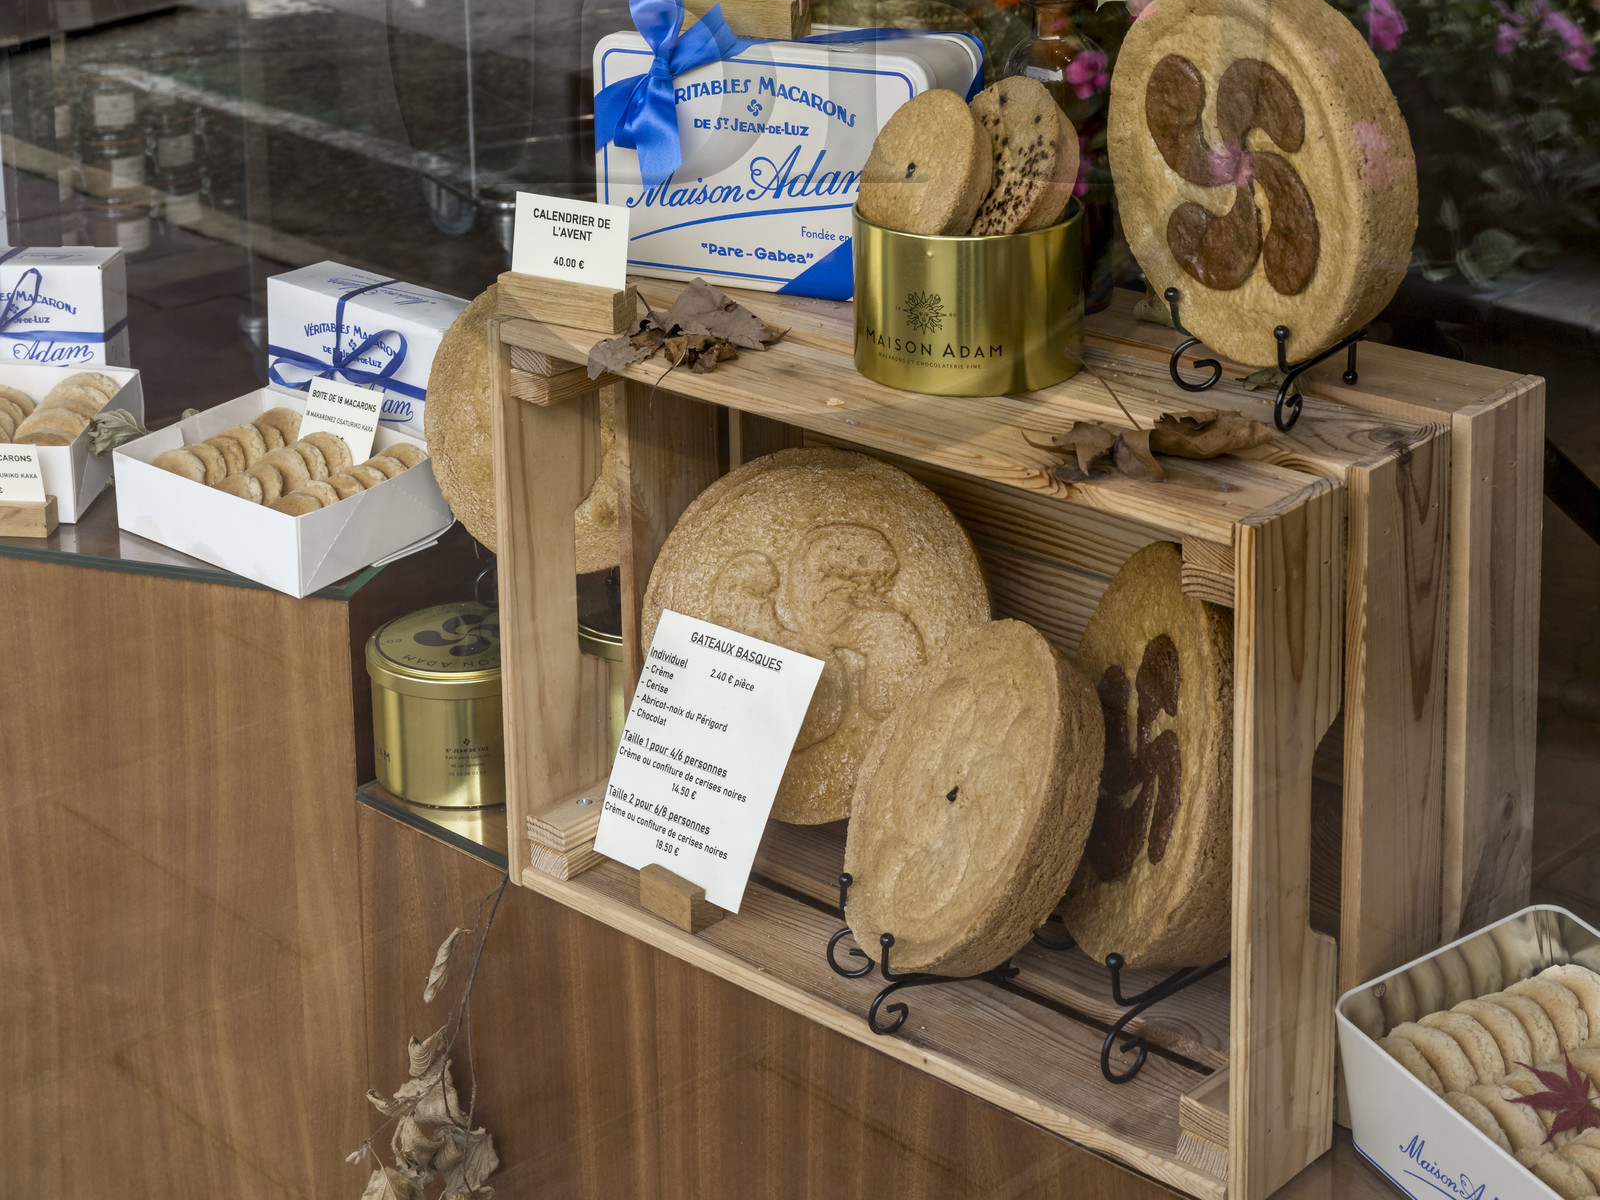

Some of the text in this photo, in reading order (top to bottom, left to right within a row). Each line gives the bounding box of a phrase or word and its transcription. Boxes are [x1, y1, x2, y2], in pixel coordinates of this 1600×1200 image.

[675, 76, 857, 128] RITABLES MACARONS
[694, 118, 711, 130] DE
[731, 118, 809, 137] JEAN-DE-LUZ
[626, 171, 744, 208] Maison
[534, 208, 611, 230] CALENDRIER DE
[553, 226, 593, 242] L'AVENT
[801, 226, 836, 241] Fondée
[553, 256, 585, 270] 40.00 €
[16, 291, 77, 315] MACARONS
[304, 323, 398, 358] VÉRITABES MAARO
[866, 326, 1003, 359] MAISON ADAM
[13, 340, 95, 364] Adam
[342, 350, 382, 368] JEN-DE-LUZ
[879, 352, 906, 364] MACARONS
[917, 361, 964, 370] CHOCOLATERIE
[312, 390, 377, 412] BOITE DE 18 MACARONS
[311, 411, 336, 423] MAKARONEZ
[337, 417, 361, 429] OSATURIKO
[362, 424, 374, 432] KAXA
[402, 654, 452, 668] ADAM
[691, 632, 783, 671] GATEAUX BASQUES
[650, 647, 755, 692] Individuel 2.40 € pièce
[651, 664, 674, 680] Crème
[646, 679, 669, 695] Cerise
[637, 708, 667, 727] Chocolat
[641, 694, 729, 733] Abricot-noix du Périgord
[624, 730, 728, 778] Taille 1 pour 4/6 personnes
[619, 746, 747, 803] Crème ou confiture de cerises noires
[672, 783, 697, 800] 14.50 €
[609, 785, 711, 835] Taille 2 pour 6/8 personnes
[604, 802, 728, 860] Crème ou confiture de cerises noires
[656, 839, 680, 857] 18.50 €
[1399, 1135, 1459, 1193] Maison
